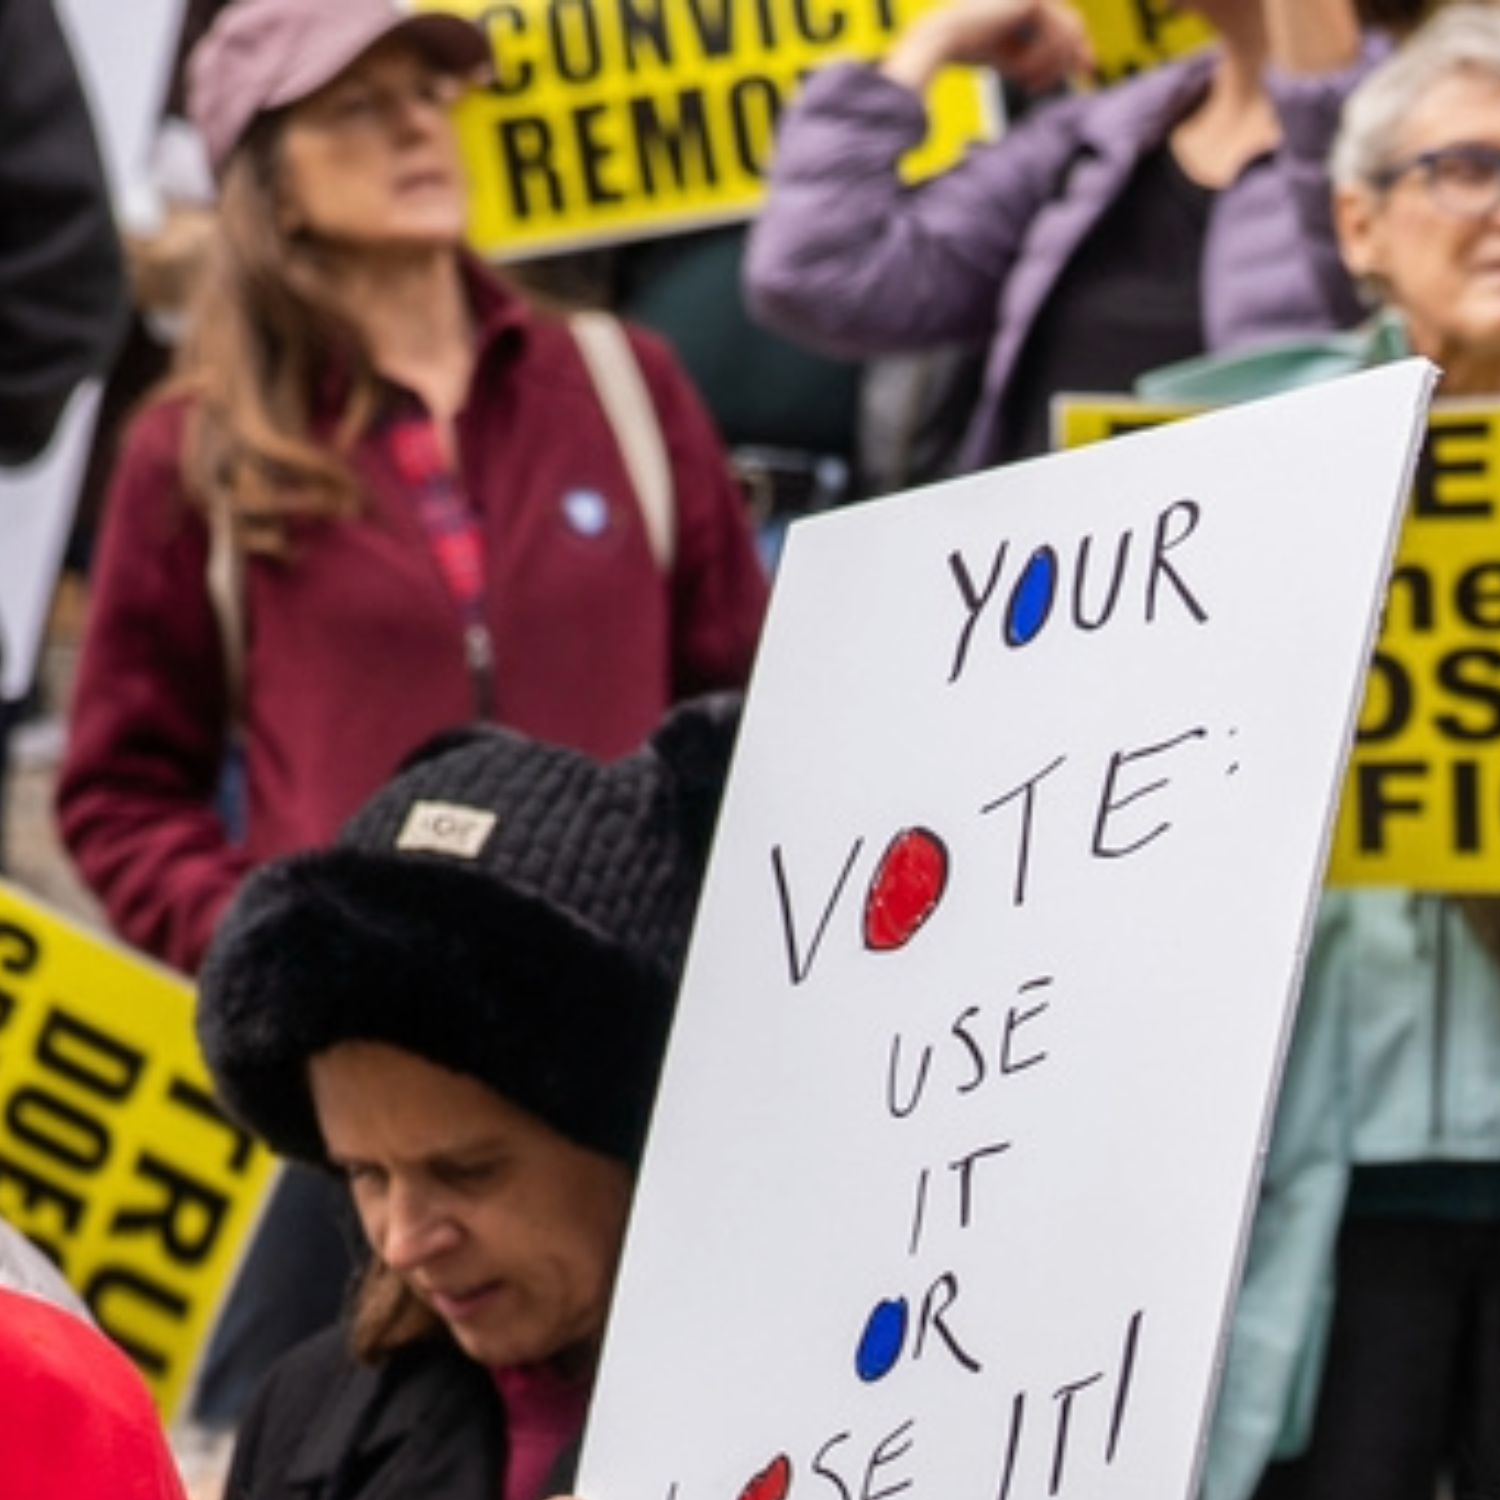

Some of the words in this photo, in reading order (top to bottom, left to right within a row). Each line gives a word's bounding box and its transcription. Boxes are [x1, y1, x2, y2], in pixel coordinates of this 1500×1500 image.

[948, 500, 1208, 682] YOUR
[771, 728, 1238, 985] VOTE:
[889, 977, 1052, 1118] USE
[910, 1143, 1010, 1254] IT
[854, 1271, 982, 1384] OR
